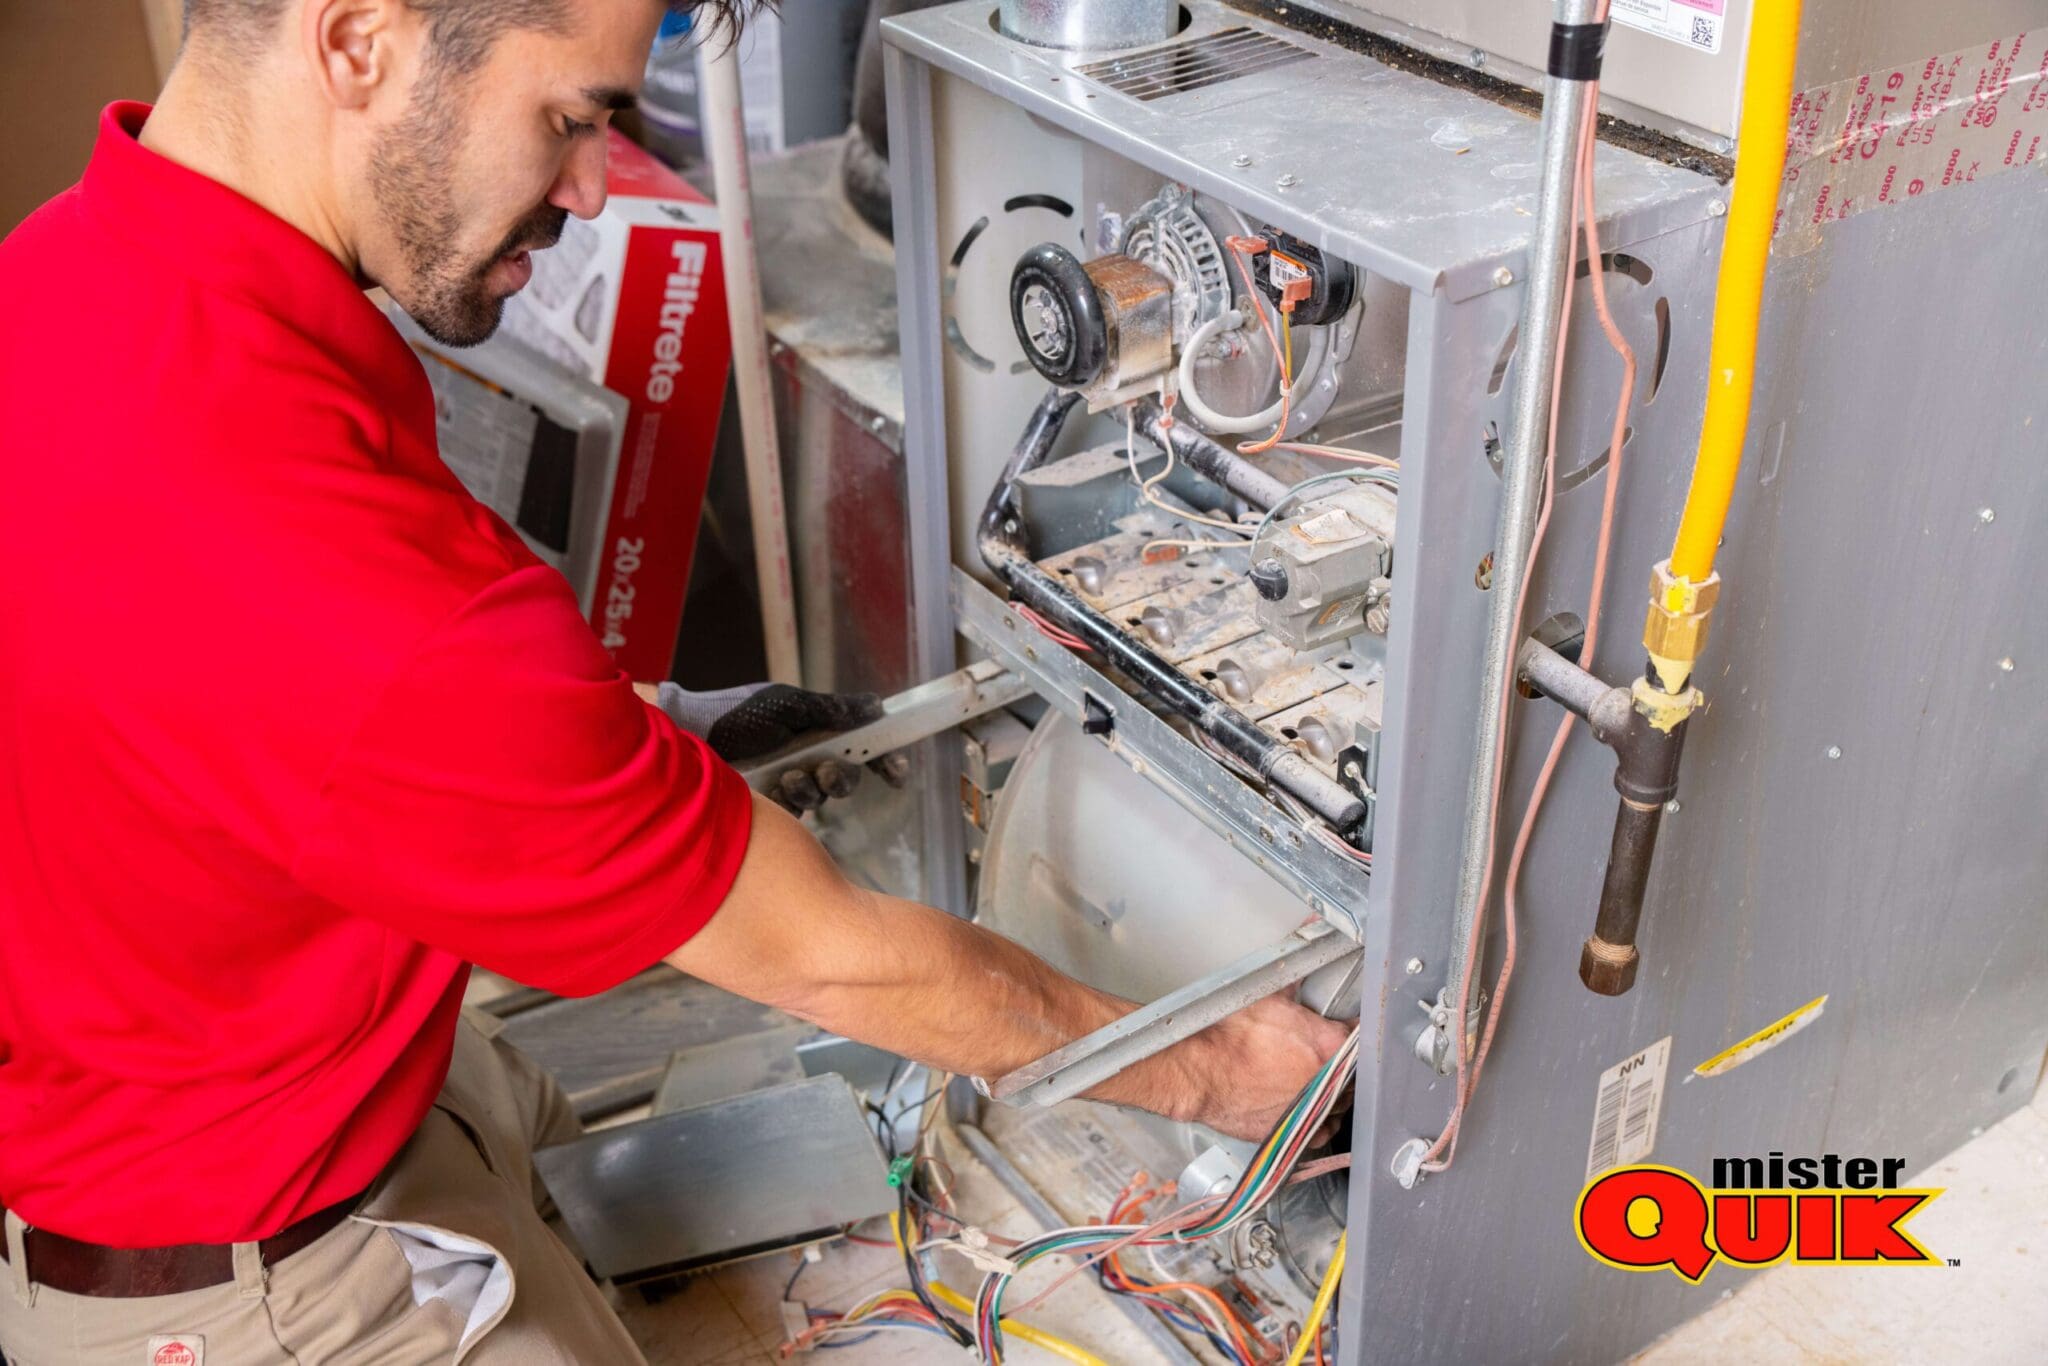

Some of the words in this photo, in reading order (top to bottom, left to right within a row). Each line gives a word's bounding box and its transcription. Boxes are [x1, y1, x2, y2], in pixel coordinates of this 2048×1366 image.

[2003, 130, 2022, 165] 0800
[1879, 165, 1896, 201] 0800
[1942, 149, 1960, 186] 0800
[646, 239, 707, 404] Filtrete
